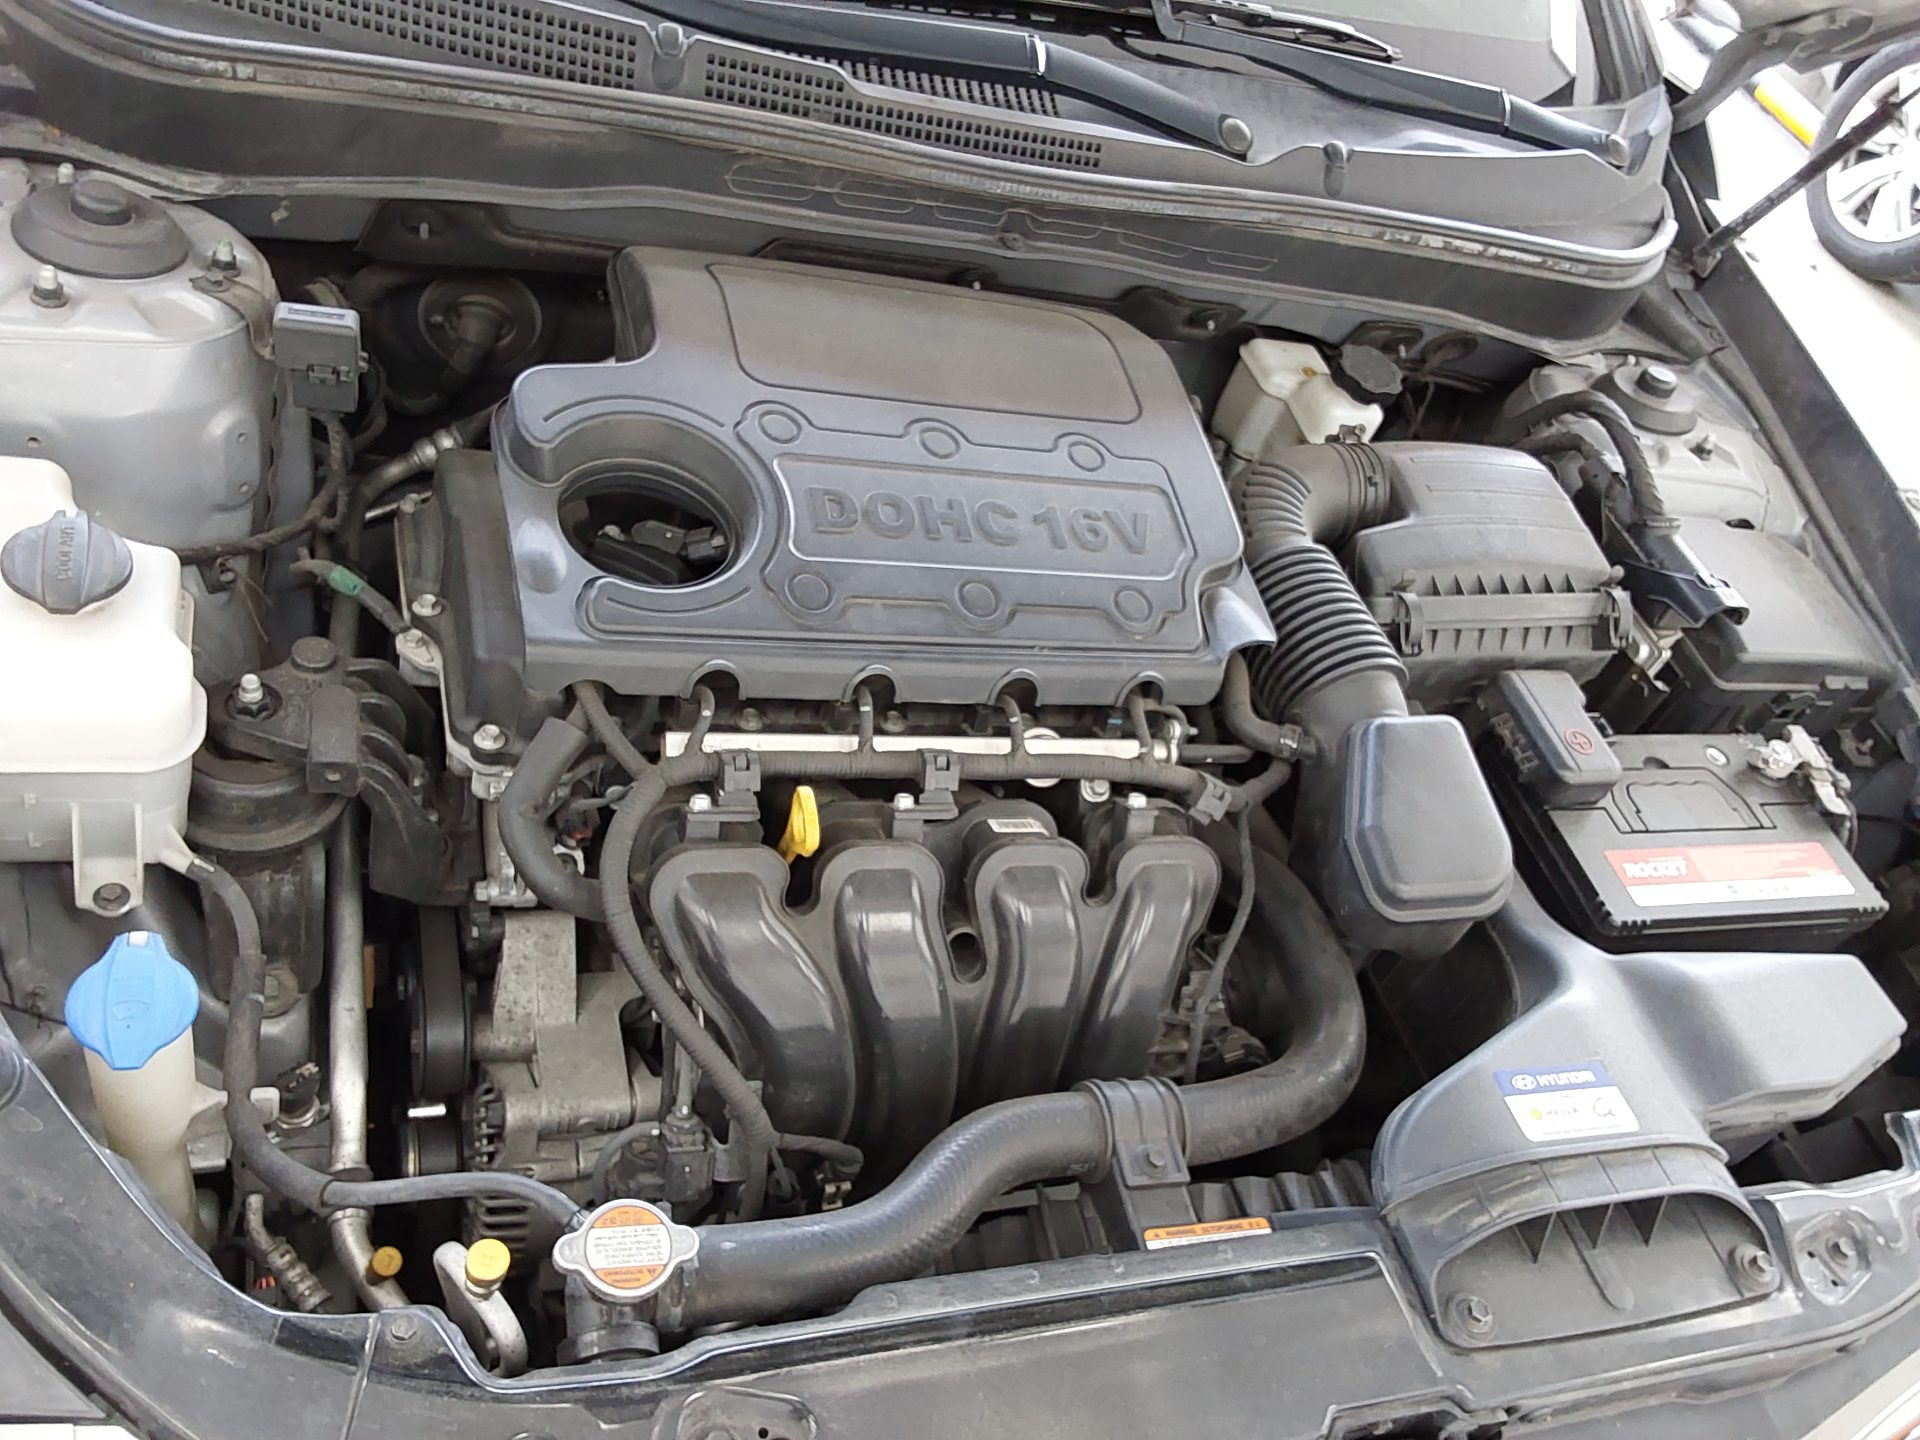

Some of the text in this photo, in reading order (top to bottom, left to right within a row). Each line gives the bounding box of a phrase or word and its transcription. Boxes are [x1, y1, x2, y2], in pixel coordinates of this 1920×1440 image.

[804, 486, 1149, 554] DOHC 16V
[1622, 859, 1688, 878] ROCKET
[1535, 1070, 1597, 1087] HYUNDAI
